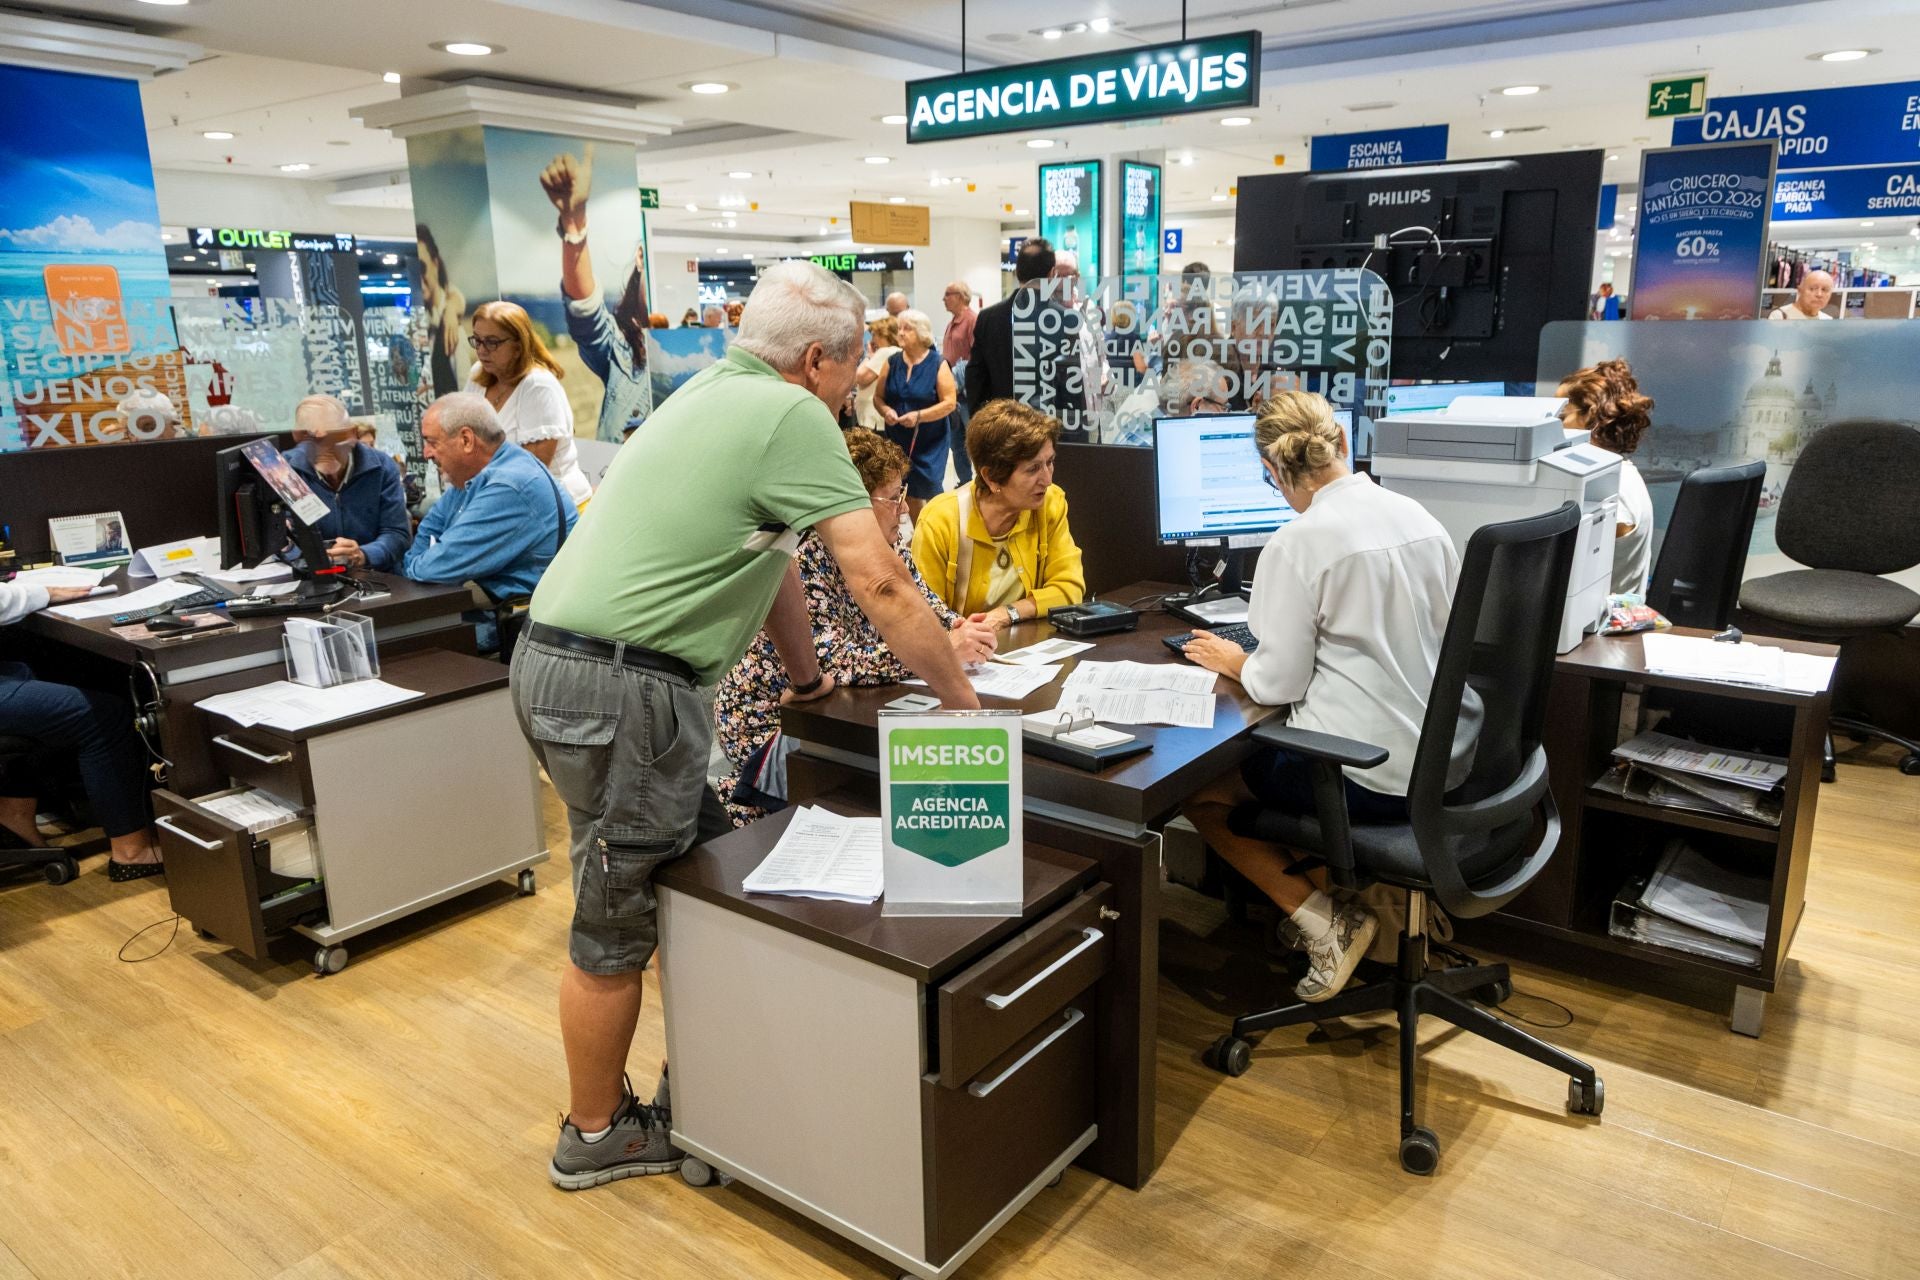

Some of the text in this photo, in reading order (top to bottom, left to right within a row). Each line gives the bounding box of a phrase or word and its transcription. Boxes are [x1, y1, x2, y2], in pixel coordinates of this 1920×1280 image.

[911, 52, 1247, 126] AGENCIA DE VIAJES
[1701, 105, 1806, 141] CAJAS
[1349, 141, 1402, 158] ESCANEA
[1670, 174, 1741, 192] CRUCERO
[1777, 179, 1825, 192] ESCANEA
[1368, 188, 1431, 207] PHILIPS
[1645, 190, 1762, 215] FANTÁSTICO 2026
[1775, 191, 1825, 204] EMBOLSA
[1785, 202, 1813, 213] PAGA
[218, 228, 292, 248] OUTLET
[1166, 232, 1177, 250] 3
[12, 324, 95, 350] SAN
[16, 352, 159, 375] EGIPTO
[381, 390, 417, 403] ATENAS
[893, 745, 1005, 766] IMSERSO
[911, 797, 989, 812] AGENCIA
[895, 815, 1006, 829] ACREDITADA
